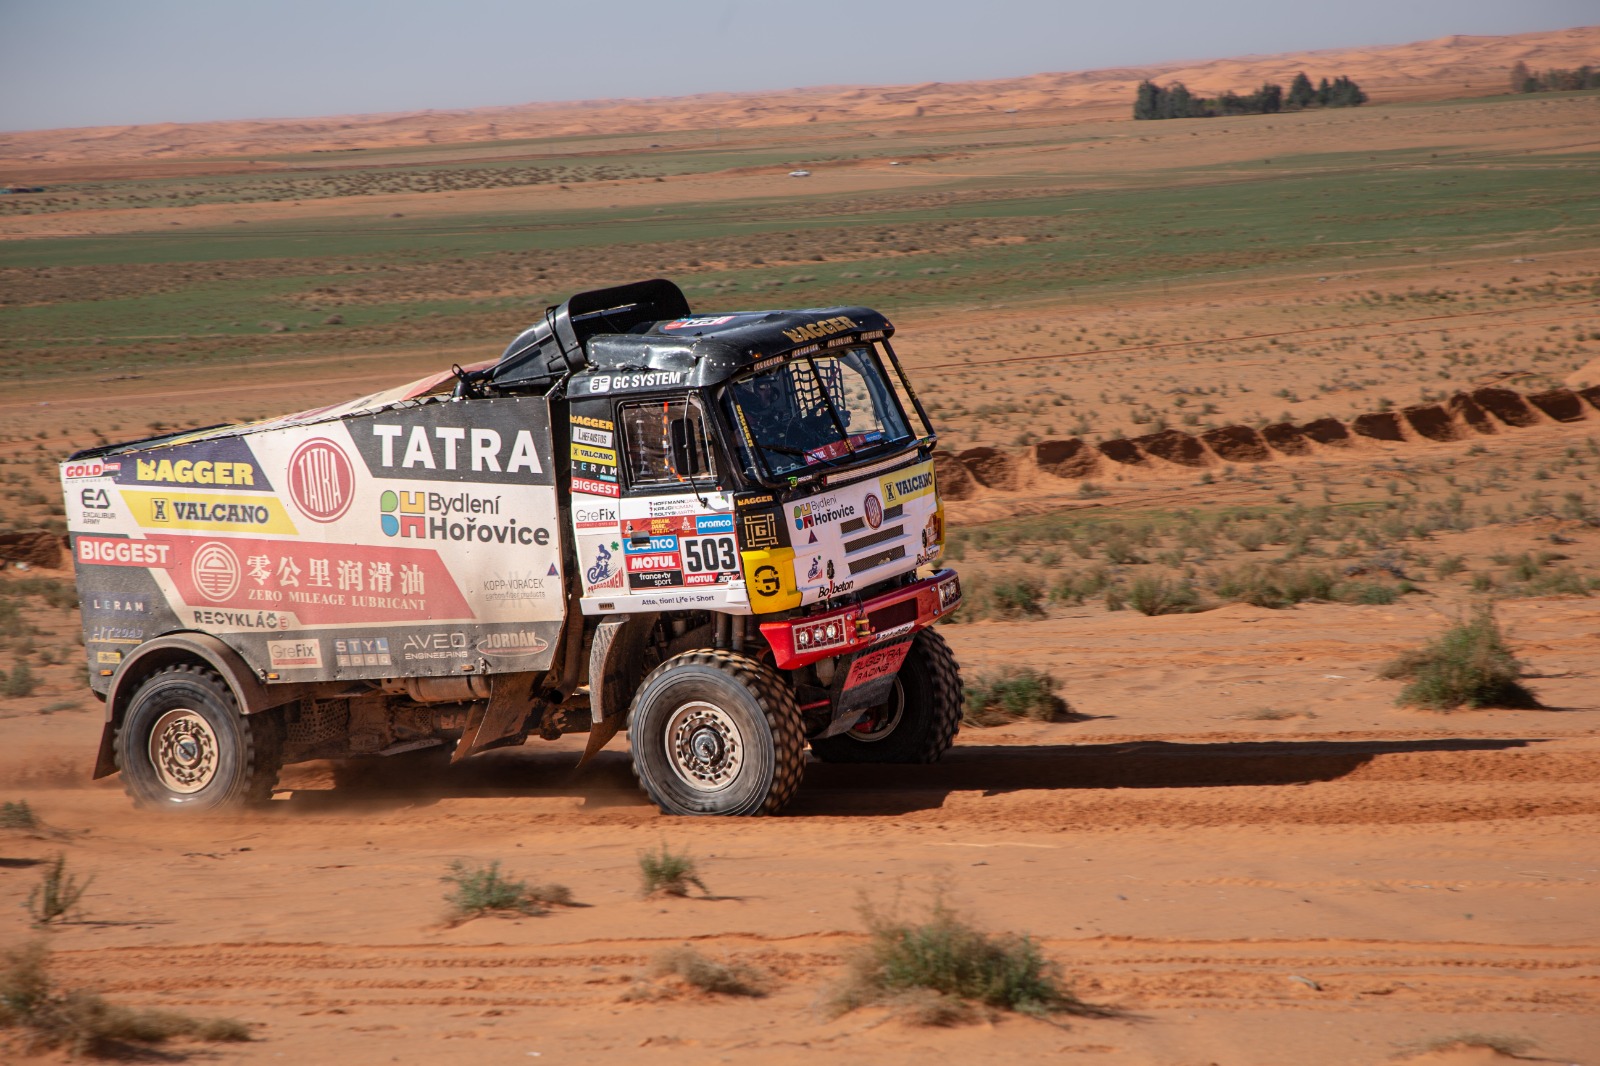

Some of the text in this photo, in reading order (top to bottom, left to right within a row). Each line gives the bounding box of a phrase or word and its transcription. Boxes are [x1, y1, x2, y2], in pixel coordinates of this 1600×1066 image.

[782, 316, 858, 343] BAGGER
[612, 372, 680, 389] GC SYSTEM
[570, 416, 613, 430] BAGGER
[373, 424, 543, 474] TATRA
[580, 449, 613, 460] VALCANO
[66, 465, 102, 477] GOLD
[137, 459, 254, 485] BAGGER
[572, 461, 617, 475] LERAM
[299, 448, 341, 512] TATRA
[572, 480, 618, 495] BIGGEST
[896, 471, 933, 495] VALCANO
[428, 492, 501, 515] Bydlení
[738, 495, 773, 506] BAGGER
[811, 495, 837, 510] Bydlení
[83, 511, 116, 519] EXCALIBUR
[173, 503, 269, 523] VALCANO
[576, 509, 616, 521] GreFix
[814, 505, 854, 526] Hořovice
[430, 517, 549, 545] Hořovice
[698, 520, 731, 528] aramco
[80, 541, 169, 563] BIGGEST
[685, 538, 736, 572] 503
[631, 555, 675, 569] MOTUL
[247, 554, 425, 595] 零公里润滑油
[654, 578, 672, 586] sport
[687, 575, 714, 583] MOTUL
[94, 600, 144, 611] LERAM
[248, 589, 426, 610] ZERO MILEAGE LUBRICANT
[337, 641, 388, 652] STYL
[404, 633, 466, 650] AVEO
[487, 630, 537, 648] JORDÁK
[271, 644, 315, 658] GreFix
[405, 651, 468, 660] ENGINEERING
[340, 656, 388, 664] 2000
[856, 663, 889, 681] RACING
